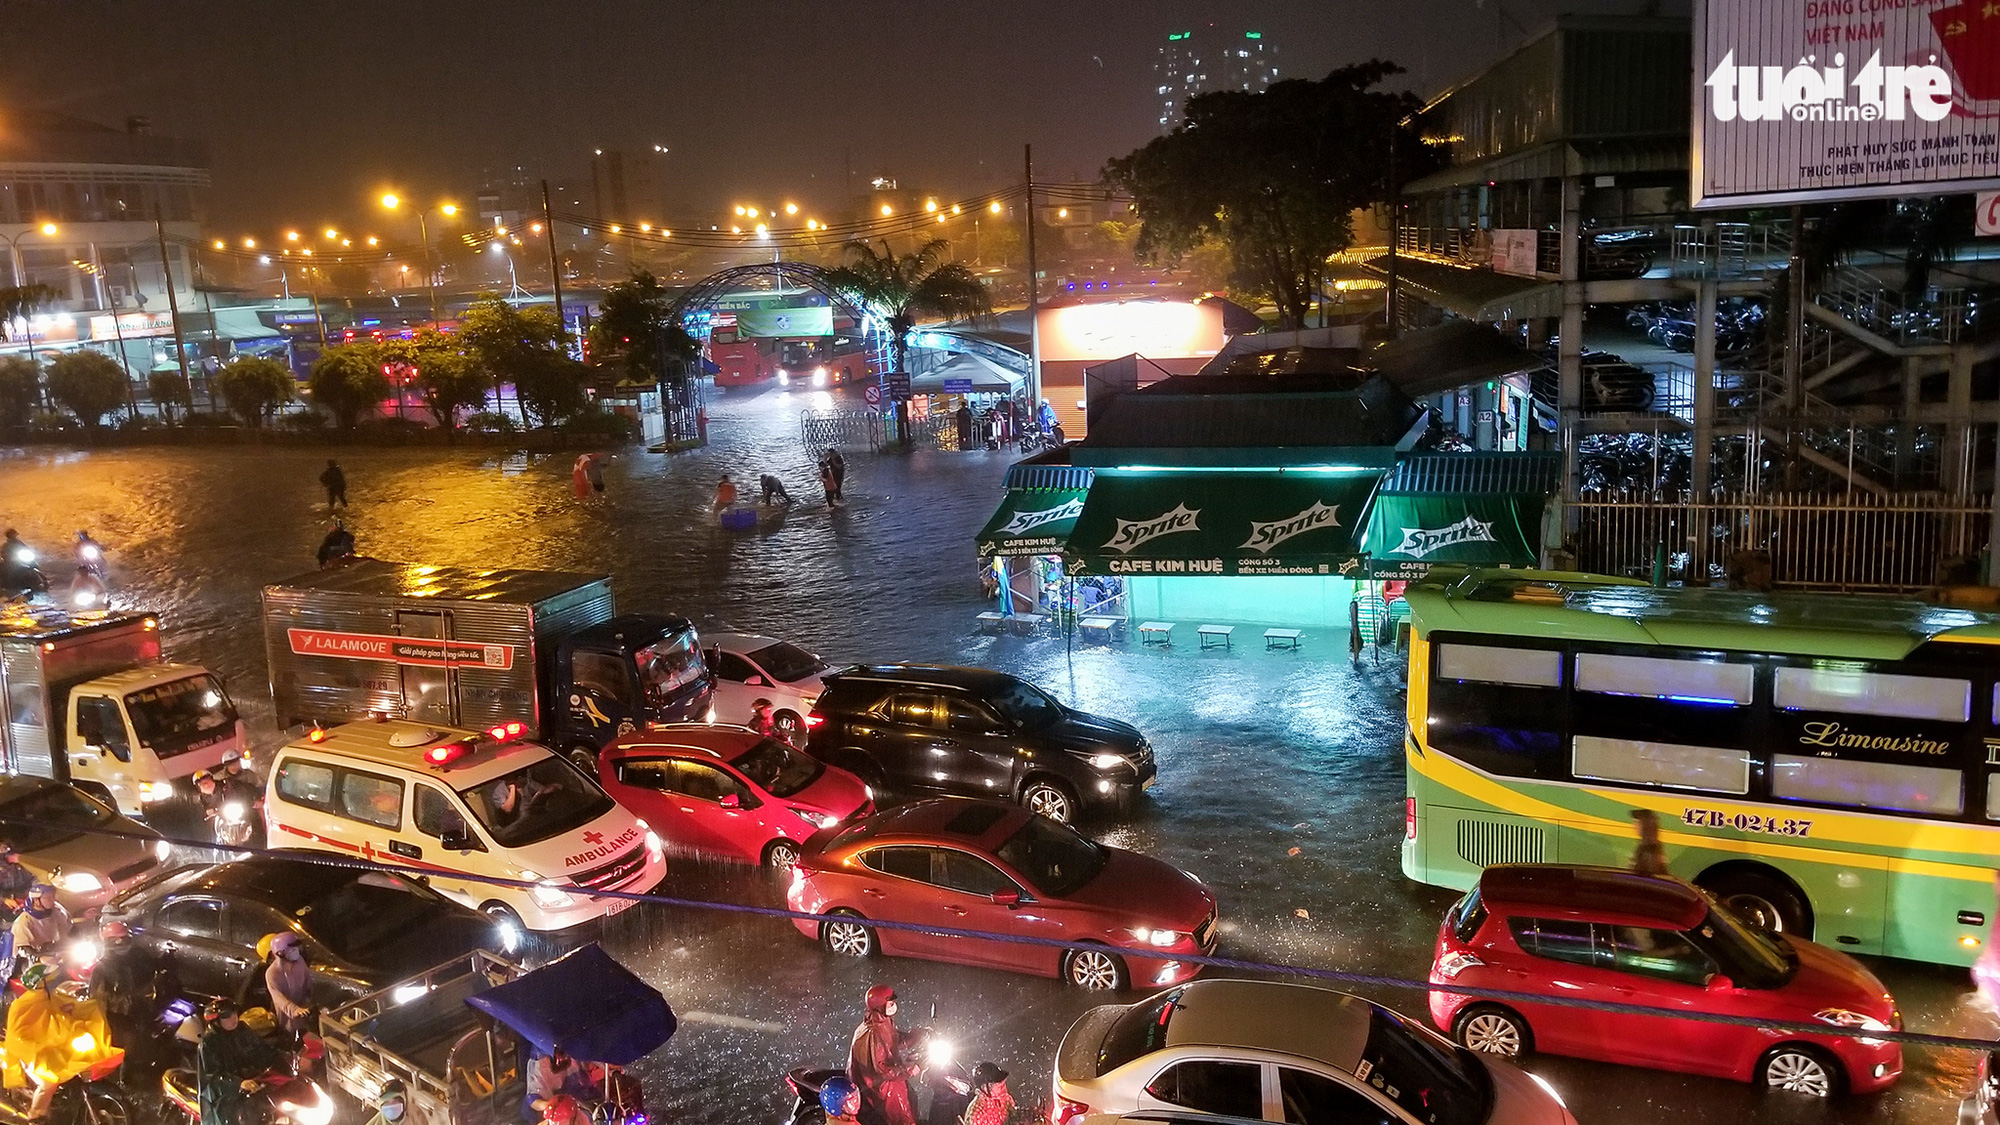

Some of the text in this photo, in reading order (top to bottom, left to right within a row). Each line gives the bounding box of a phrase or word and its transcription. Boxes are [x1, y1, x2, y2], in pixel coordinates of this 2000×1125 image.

[1845, 21, 1885, 41] NAM
[1863, 143, 1888, 156] HUY
[1479, 412, 1491, 421] A2
[1009, 503, 1084, 530] Sprite
[1251, 508, 1331, 545] Sprite
[1114, 512, 1192, 545] Sprite
[1403, 523, 1486, 550] Sprite
[1109, 557, 1223, 575] CAFE KIM HUỆ
[1400, 562, 1425, 570] CAFE
[316, 637, 387, 654] LALAMOVE
[1800, 721, 1950, 755] Limousine
[564, 828, 639, 867] AMBULANCE
